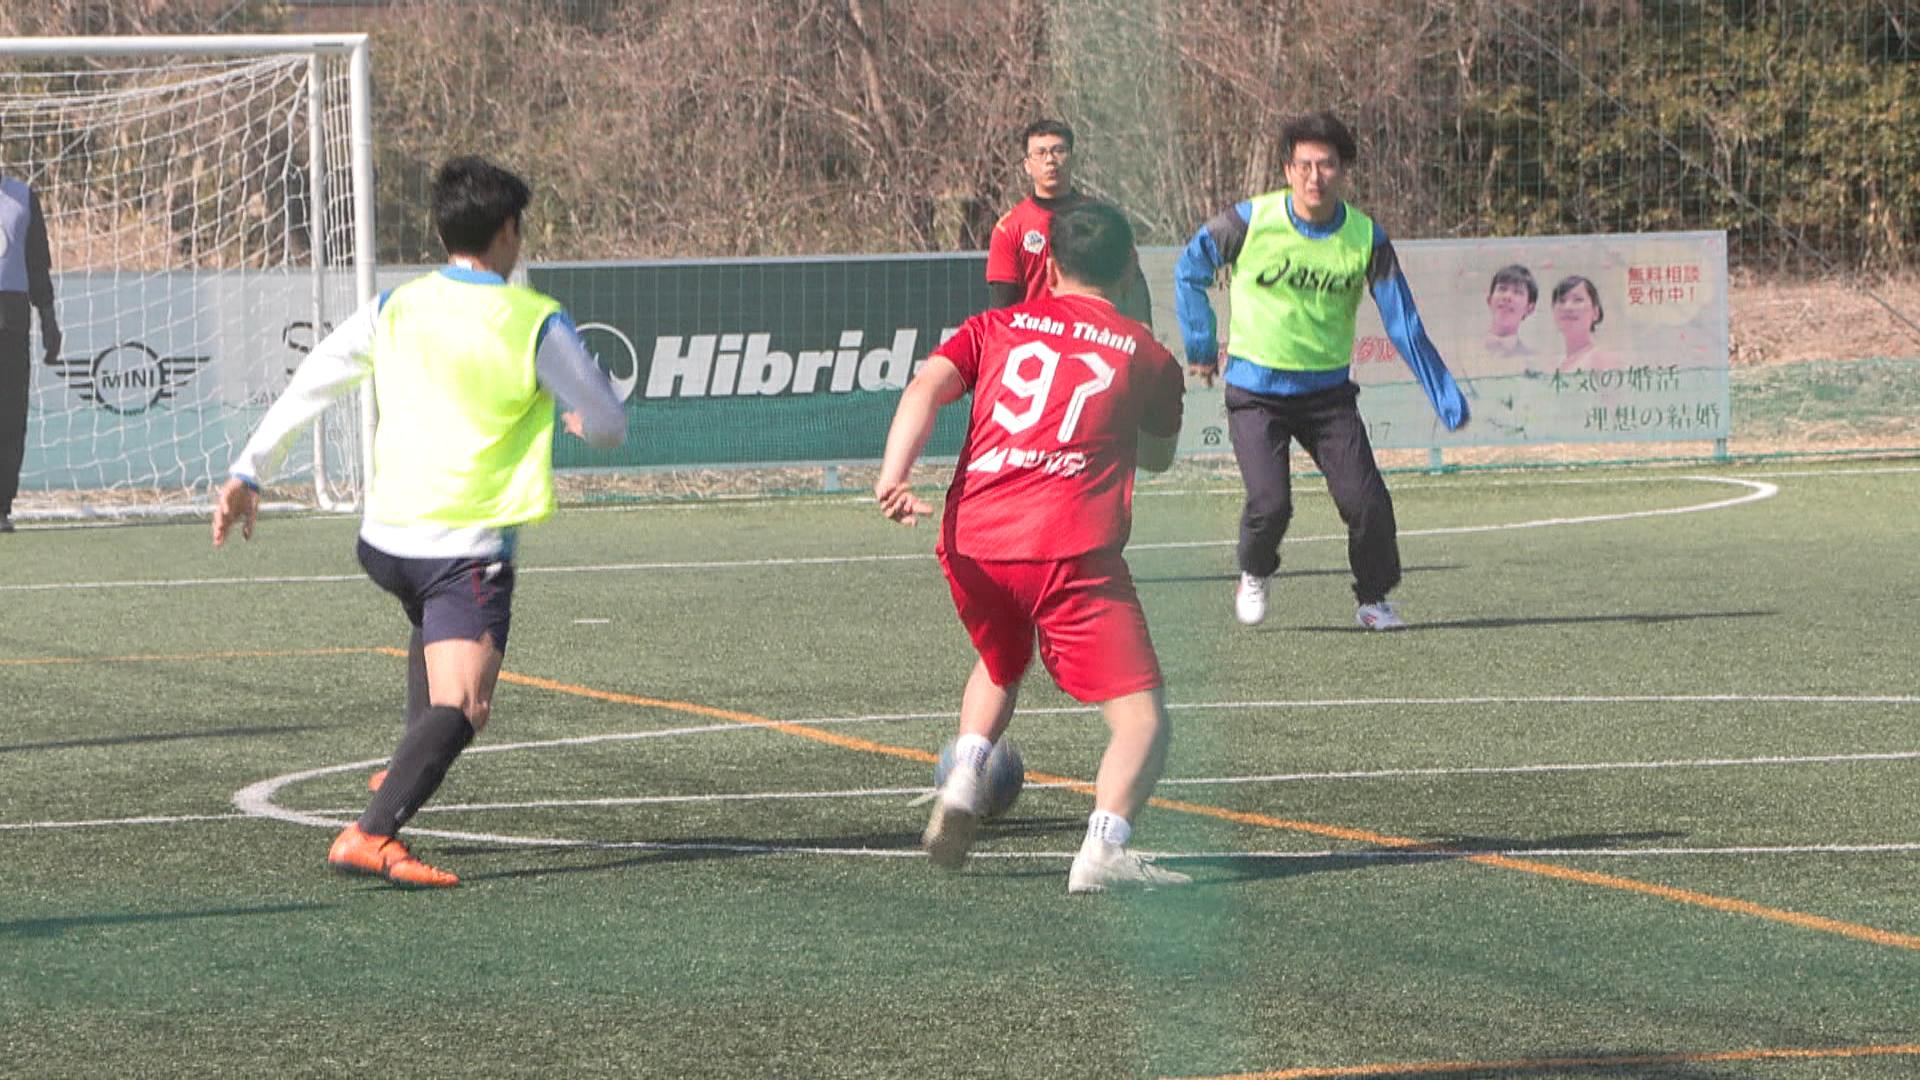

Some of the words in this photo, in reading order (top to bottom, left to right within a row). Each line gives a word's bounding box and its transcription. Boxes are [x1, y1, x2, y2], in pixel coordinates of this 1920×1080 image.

[1628, 265, 1700, 284] 無料相談
[1009, 312, 1065, 336] Xuân
[646, 328, 960, 398] Hibrid-
[102, 369, 154, 388] MINI
[991, 340, 1116, 442] 97
[1551, 365, 1680, 393] 本気の婚活
[1584, 403, 1721, 432] 理想の結婚
